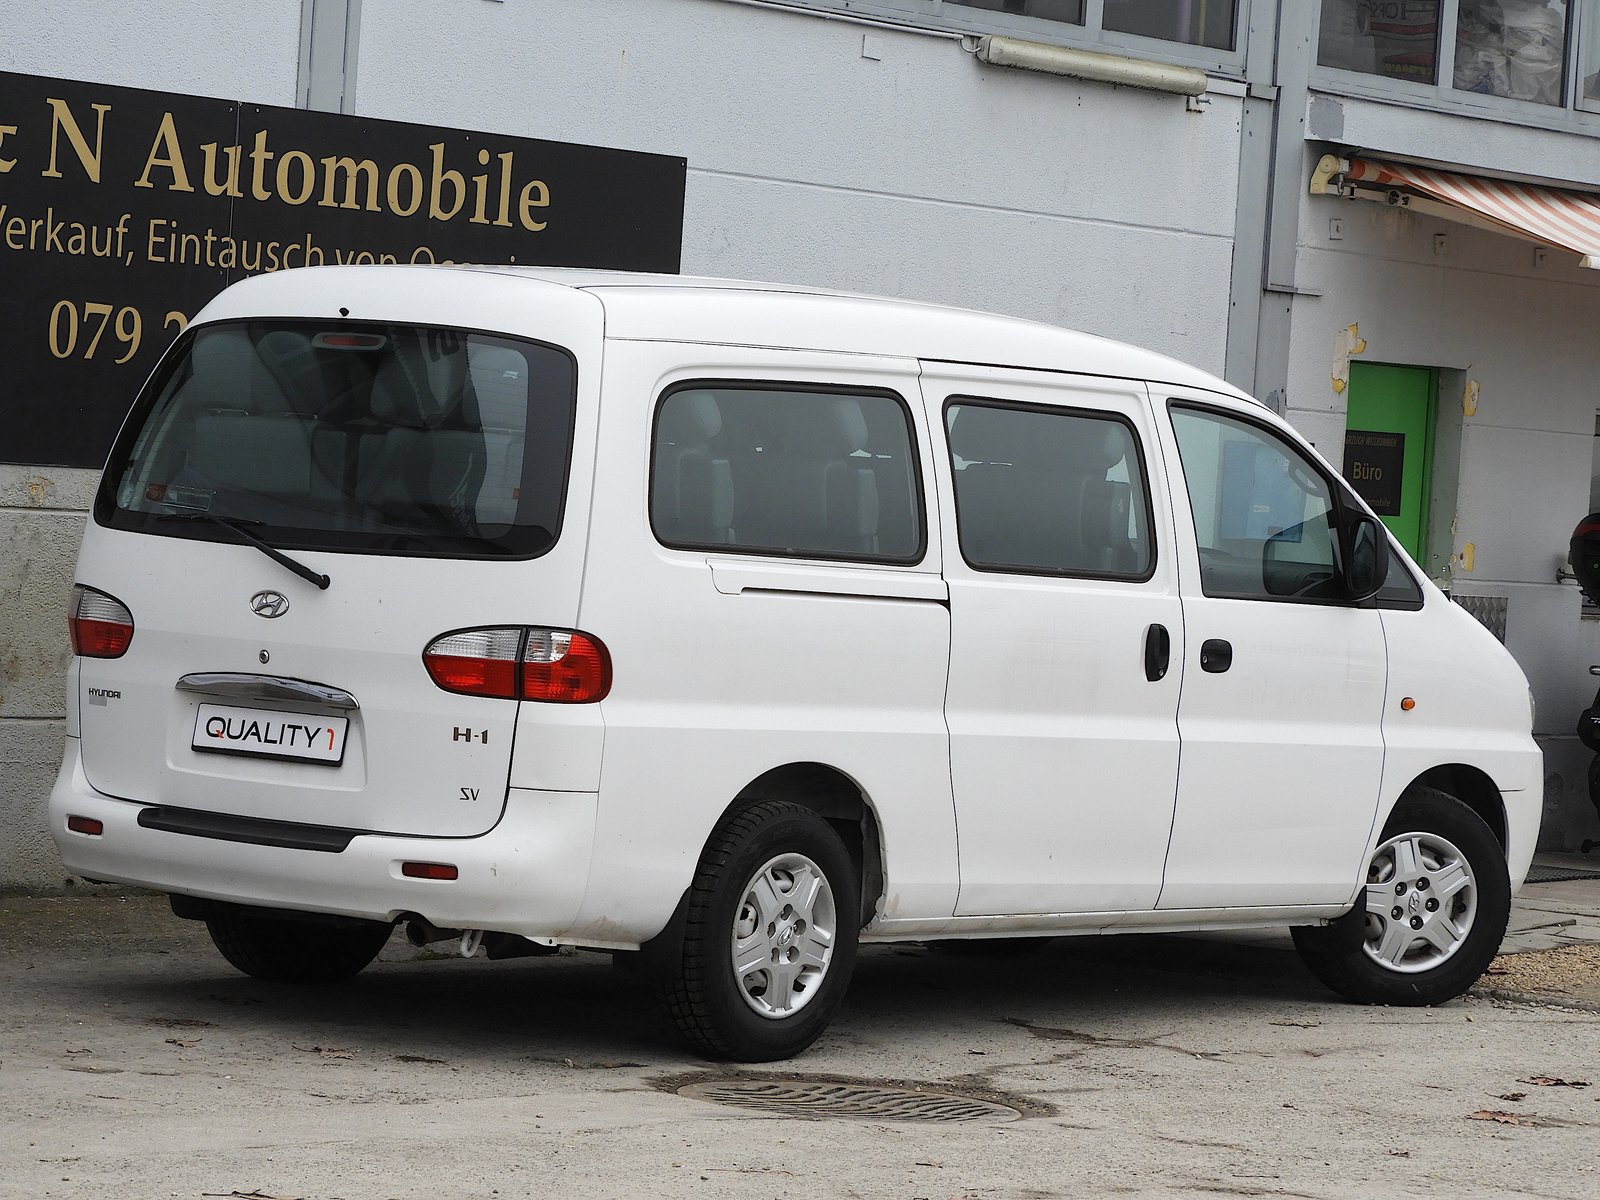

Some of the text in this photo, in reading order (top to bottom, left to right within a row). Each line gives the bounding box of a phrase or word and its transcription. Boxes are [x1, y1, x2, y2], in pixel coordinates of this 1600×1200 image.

[41, 97, 112, 184] N
[133, 111, 551, 232] Automobile
[0, 204, 325, 273] erkauf, Eintausch
[48, 300, 143, 365] 079
[1352, 461, 1383, 481] Büro
[88, 687, 122, 699] HYUNDAI
[453, 726, 488, 745] H-1
[459, 787, 480, 802] SV
